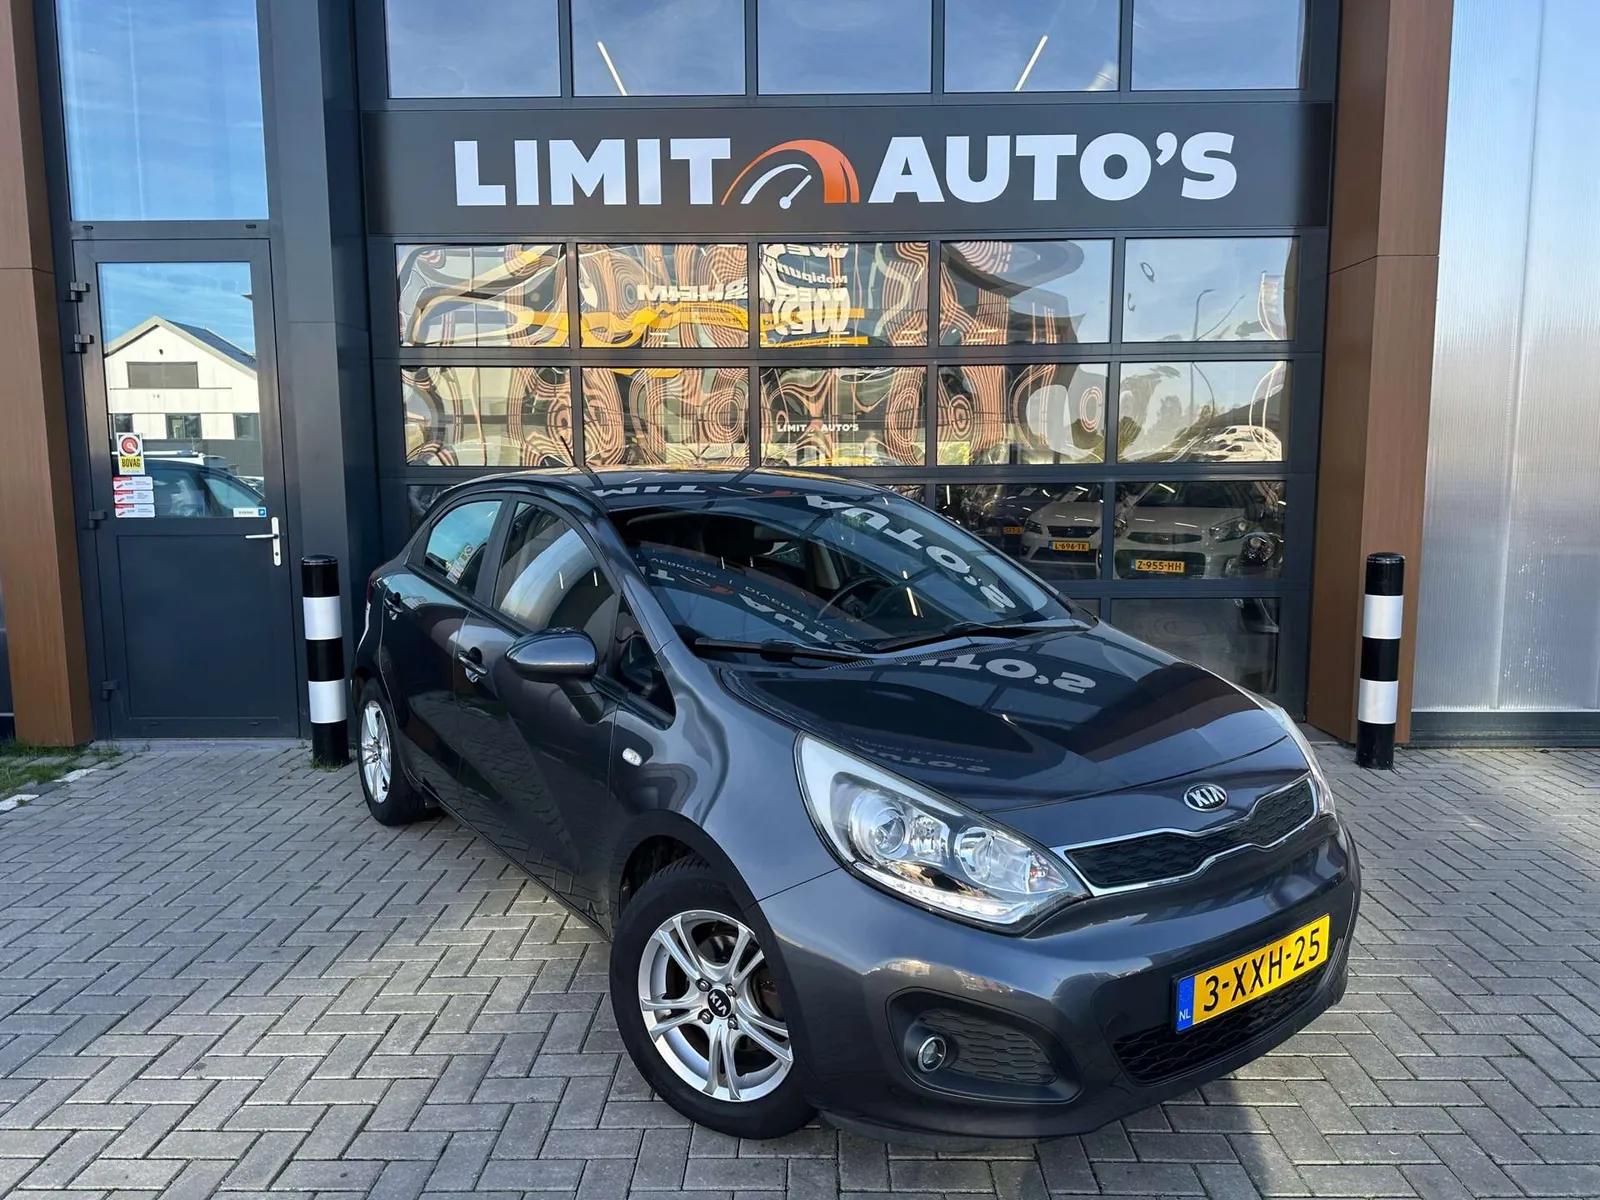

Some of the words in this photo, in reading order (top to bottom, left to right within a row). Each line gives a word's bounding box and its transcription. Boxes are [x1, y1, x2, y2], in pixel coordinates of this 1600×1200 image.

[454, 137, 731, 206] LIMIT
[867, 131, 1238, 204] AUTO'S
[777, 423, 807, 432] LIMIT
[820, 423, 859, 432] AUTO'S
[121, 458, 141, 468] BOVAG
[1054, 541, 1087, 550] L-696-TK
[1137, 560, 1183, 571] Z-955-HH
[1188, 786, 1226, 806] KIA
[1179, 1008, 1191, 1021] NL
[1203, 926, 1321, 1013] 3-XXH-25
[708, 992, 727, 1016] KIA
